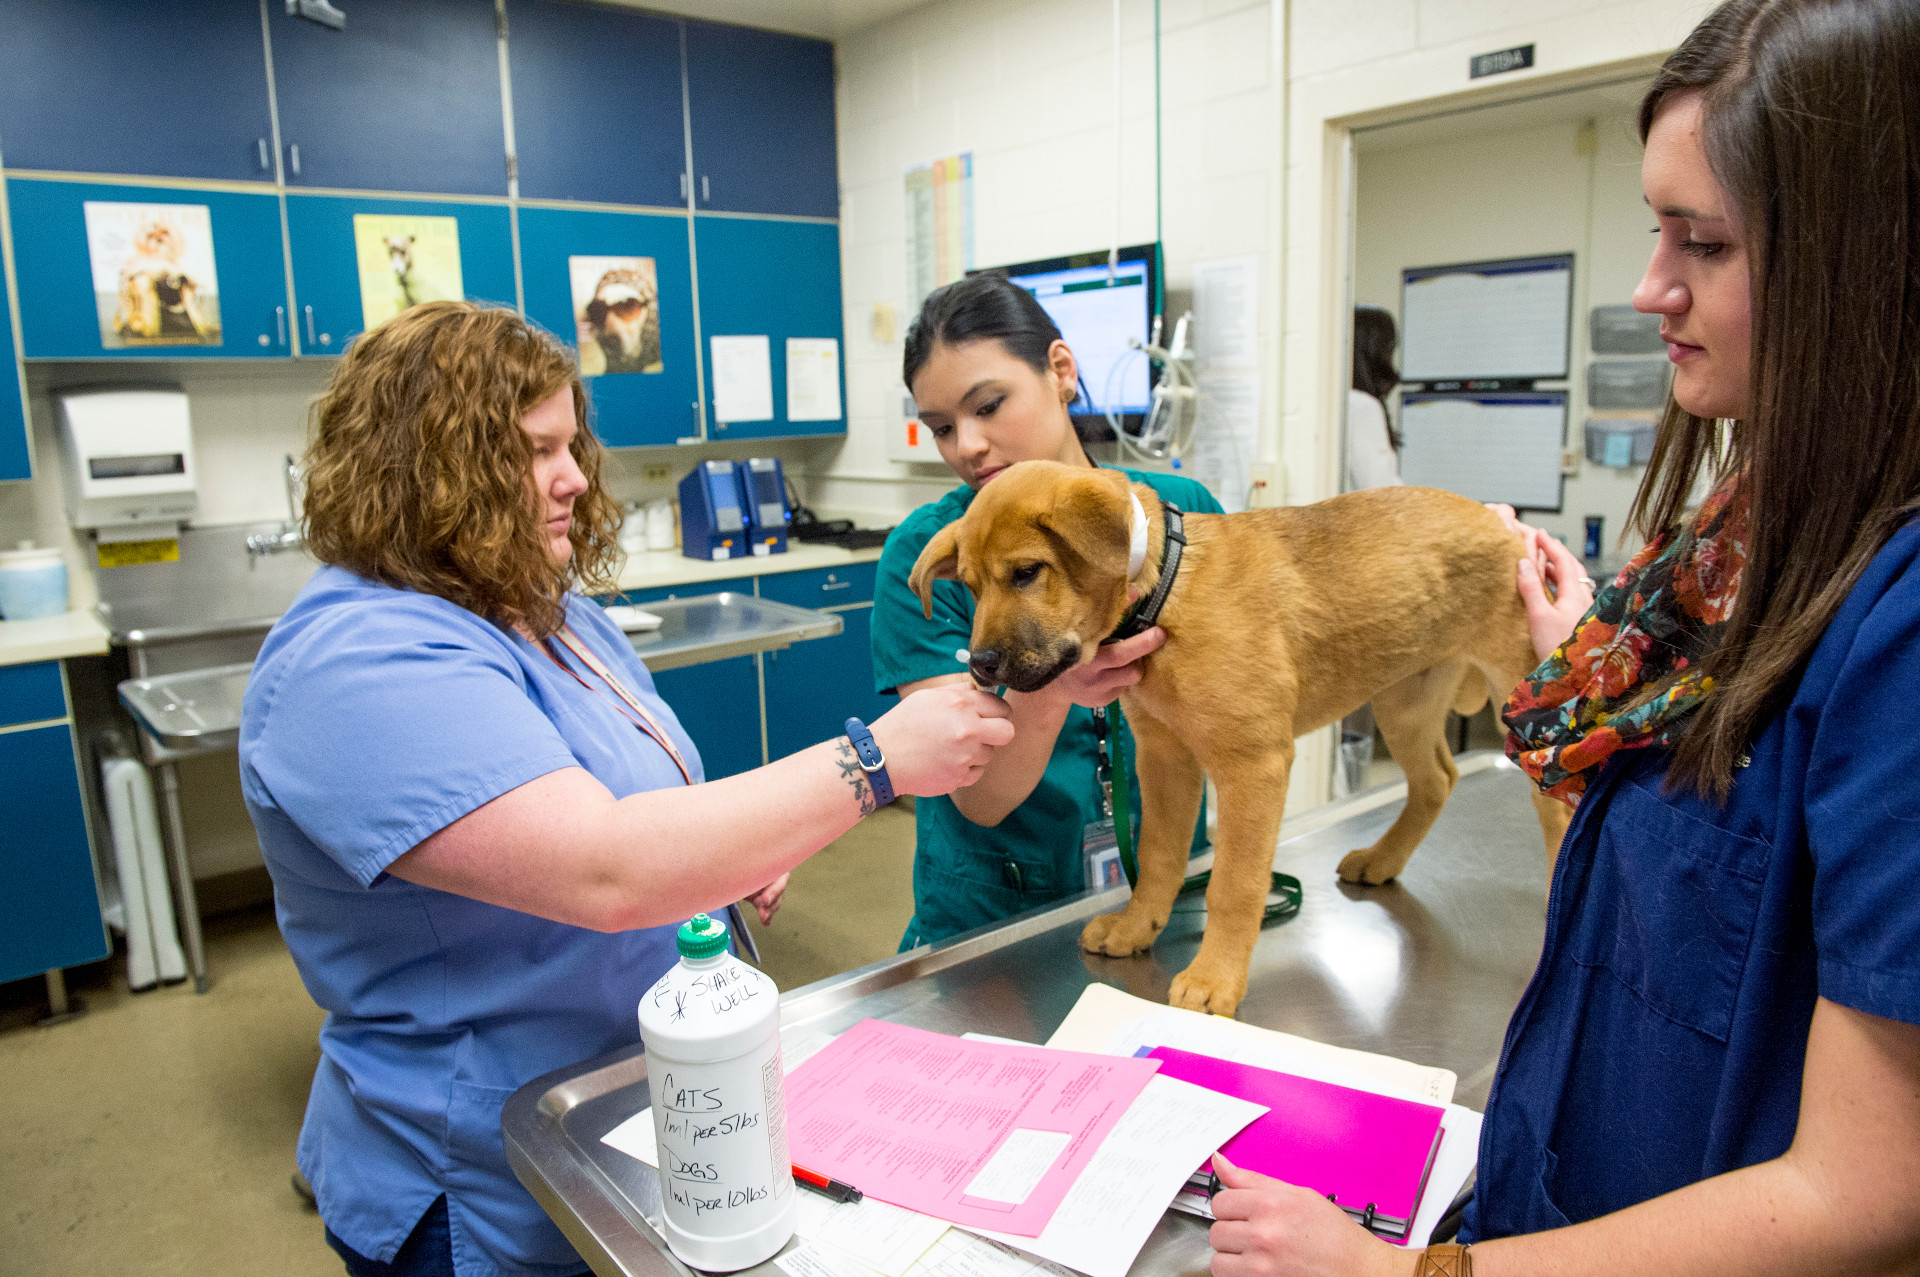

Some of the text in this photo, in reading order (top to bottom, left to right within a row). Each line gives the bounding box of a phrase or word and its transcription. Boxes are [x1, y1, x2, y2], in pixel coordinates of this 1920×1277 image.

[691, 966, 741, 997] SHAKE
[710, 984, 759, 1015] WELL
[662, 1073, 723, 1111] CATS
[662, 1143, 719, 1181] DOGS
[727, 1184, 768, 1209] 10lbs
